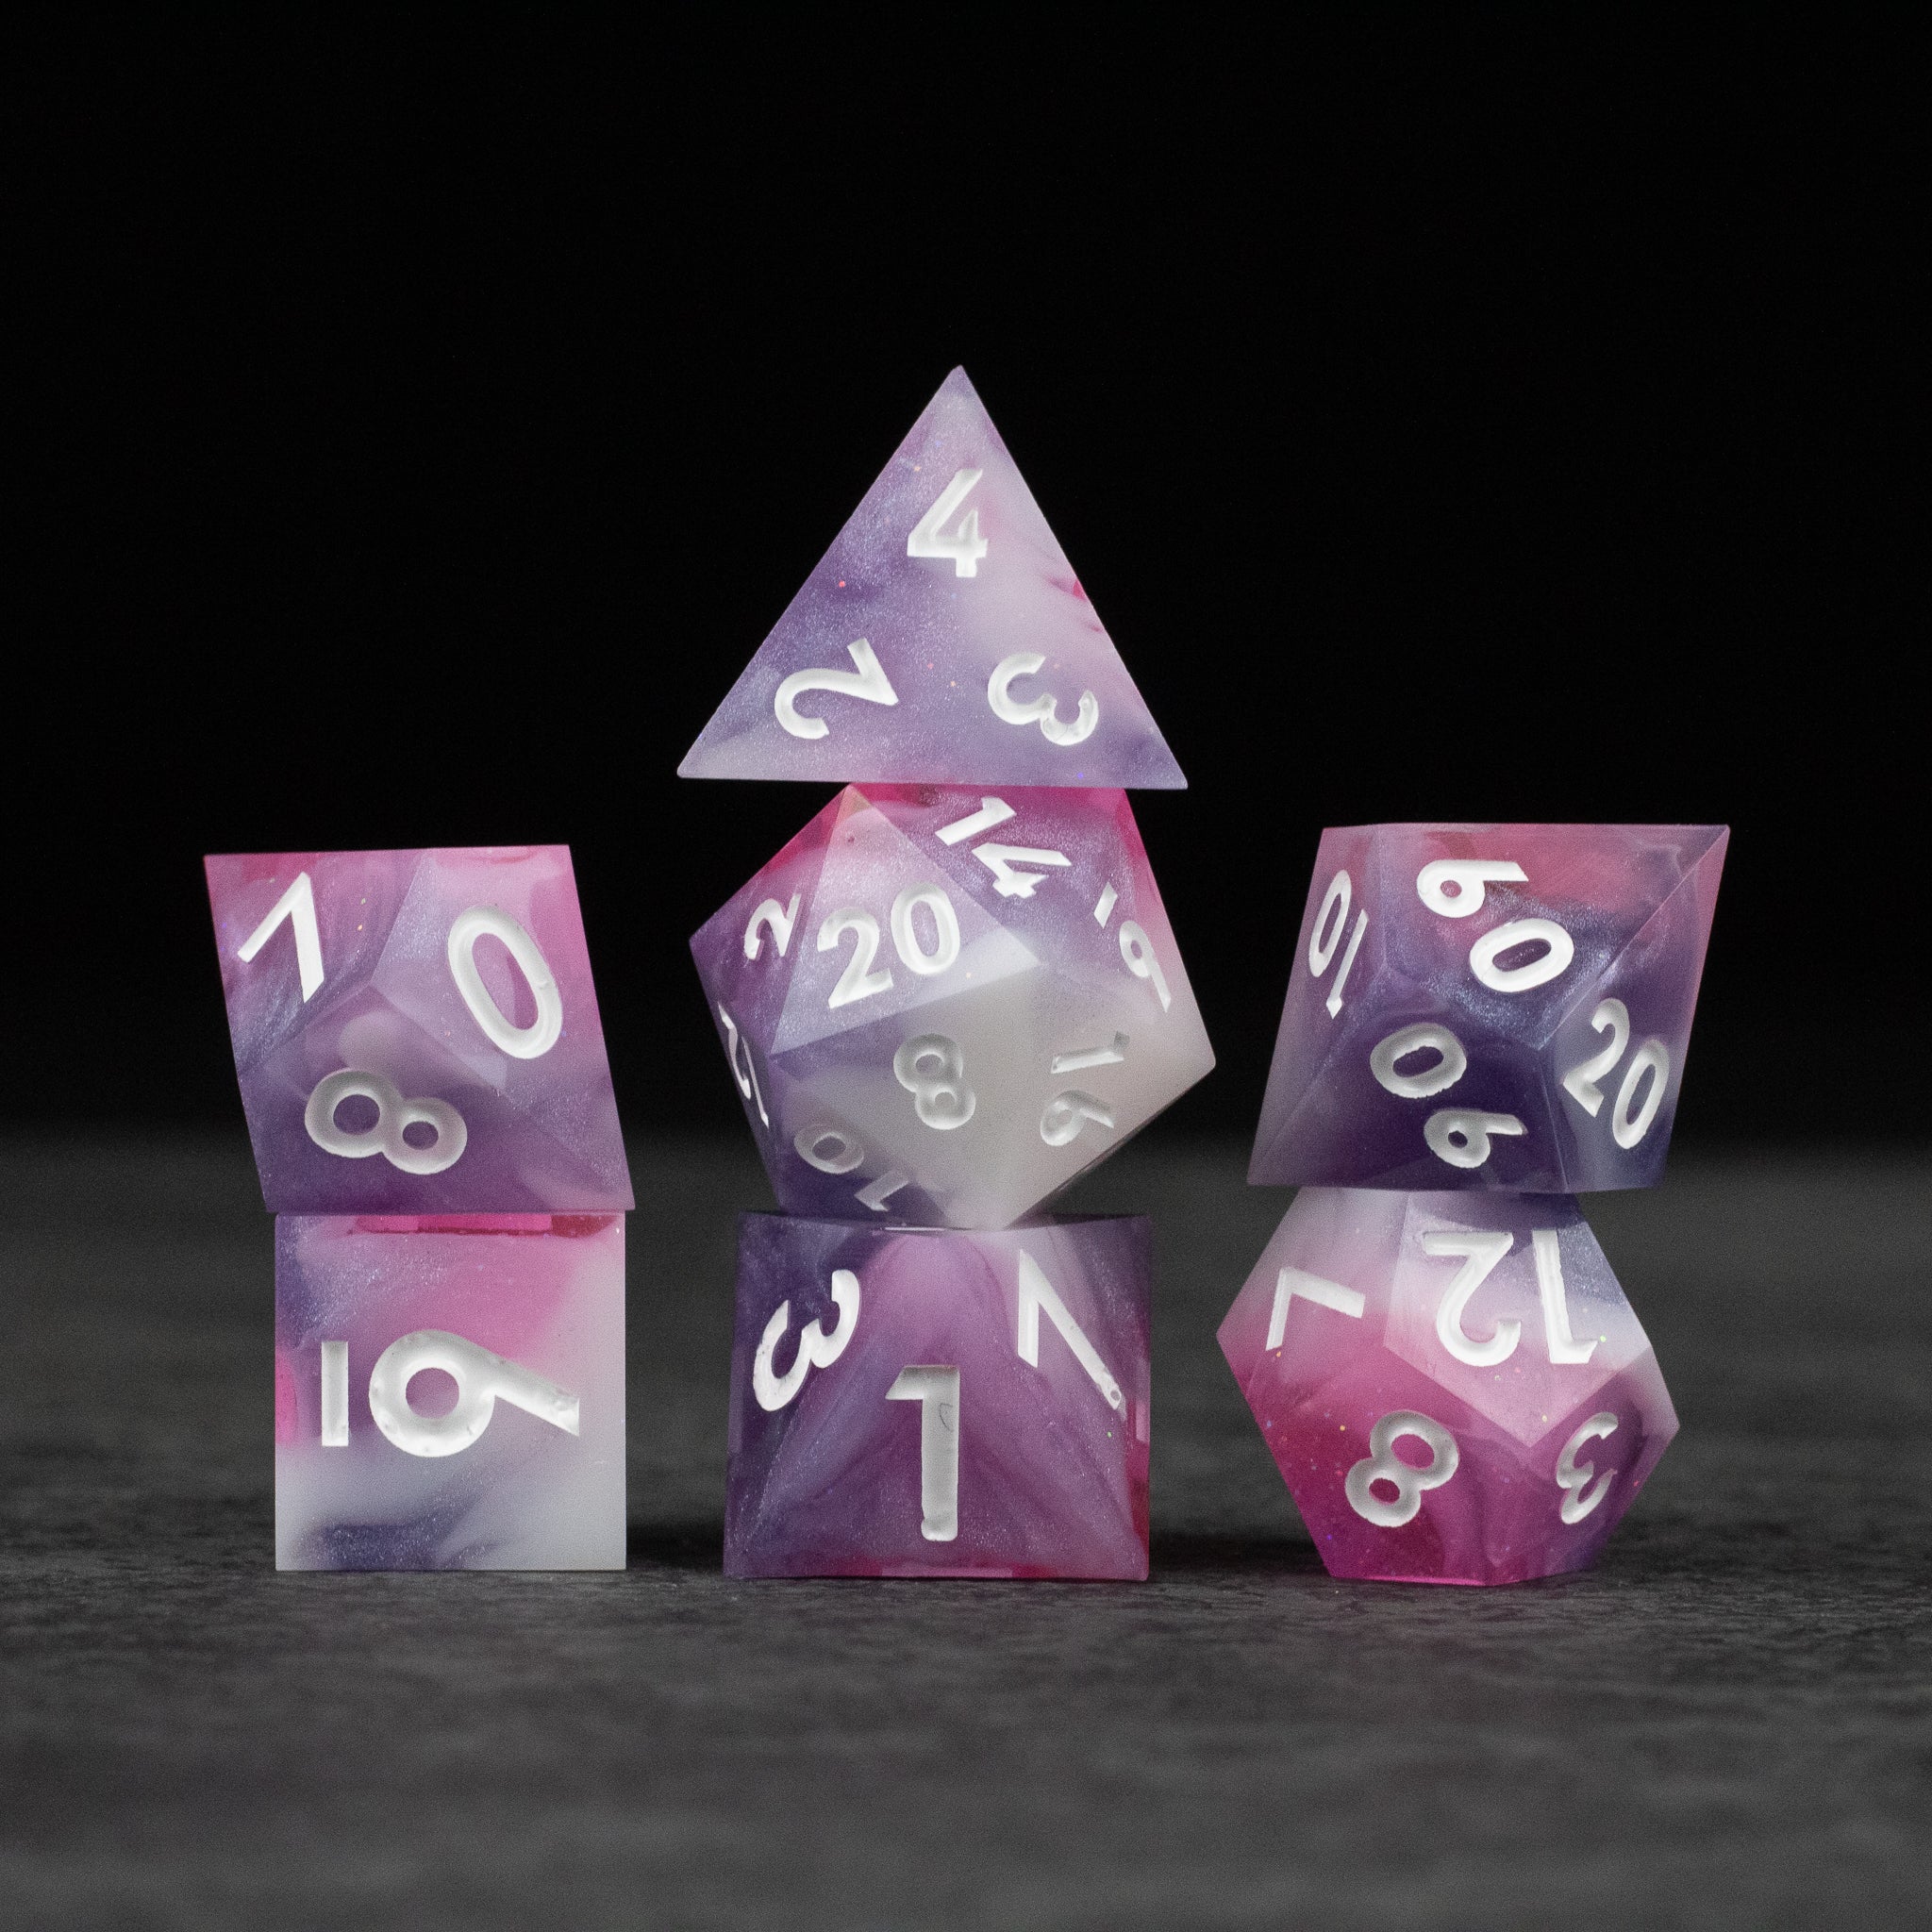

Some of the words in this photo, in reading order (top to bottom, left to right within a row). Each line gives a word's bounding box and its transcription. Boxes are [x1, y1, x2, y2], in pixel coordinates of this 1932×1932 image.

[907, 468, 989, 578] 4
[774, 638, 899, 740] 2
[987, 652, 1099, 746] 3
[935, 796, 1072, 899] 14
[743, 892, 802, 960] 2
[817, 881, 961, 1009] 20
[304, 1067, 469, 1175] 8
[892, 1033, 976, 1131] 8
[1562, 997, 1670, 1150] 20
[752, 1268, 861, 1412] 3
[1422, 1229, 1600, 1368] 12
[884, 1364, 961, 1541] 1
[1344, 1408, 1460, 1528] 8
[1555, 1411, 1619, 1525] 3
